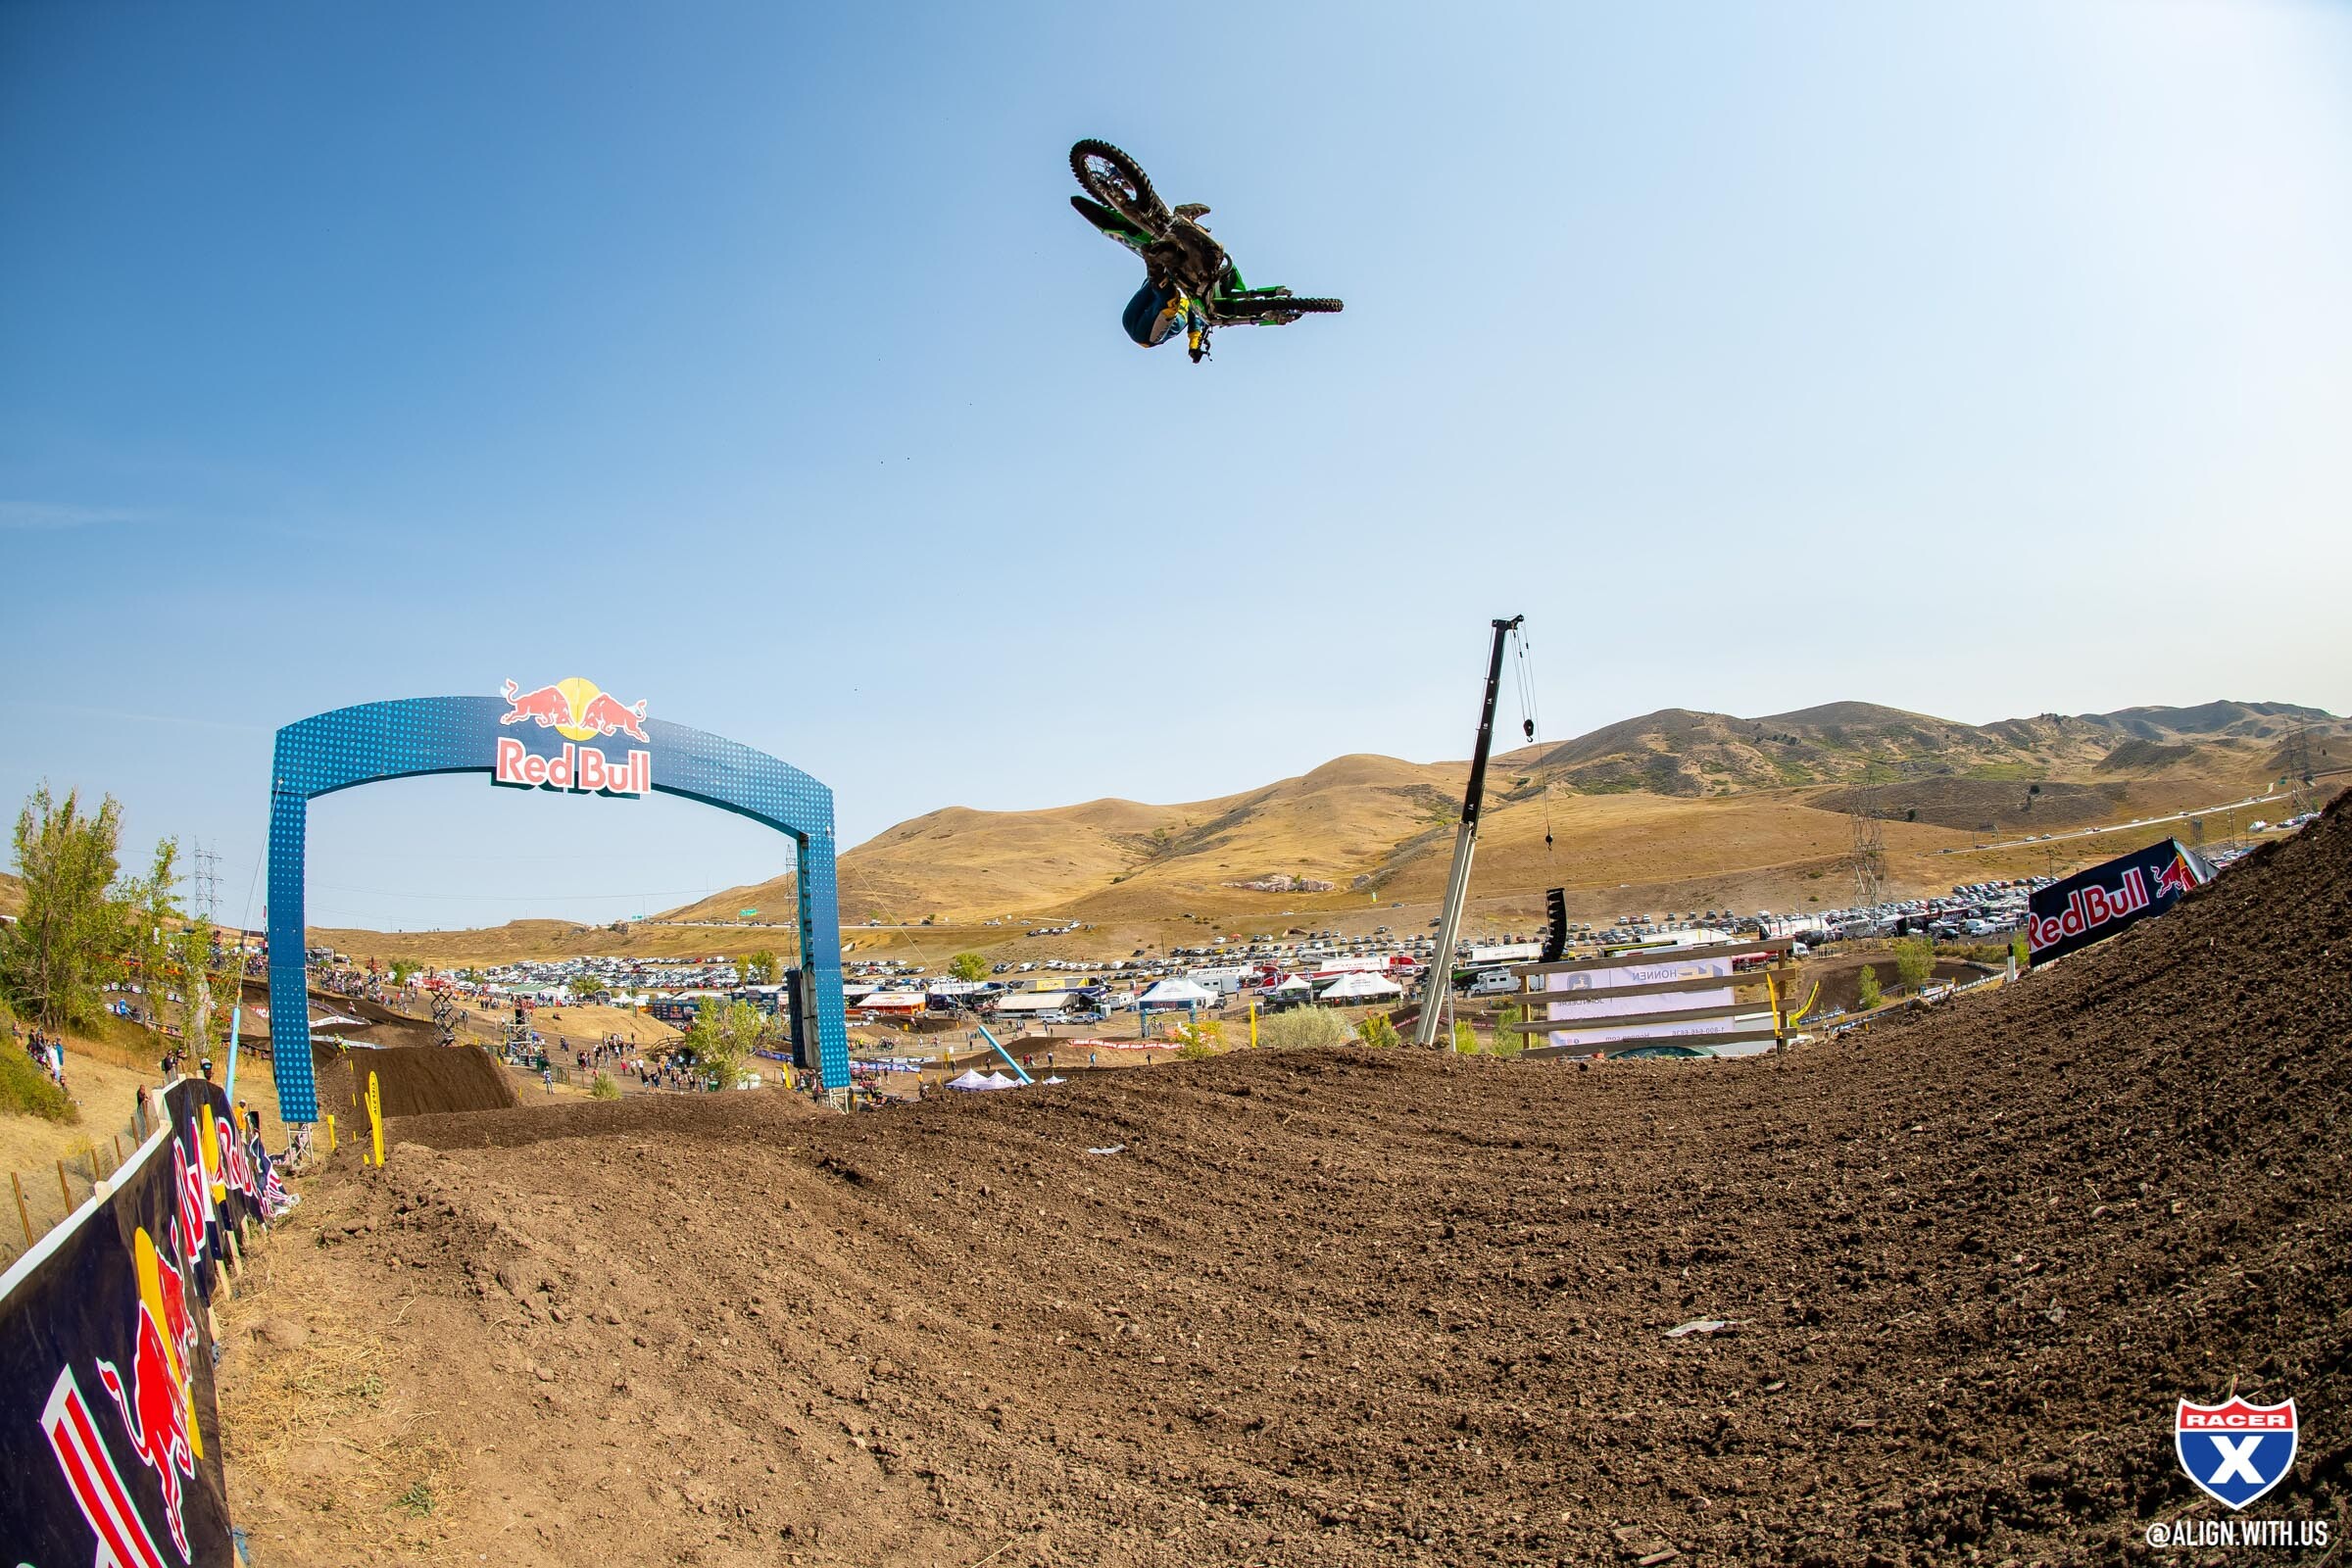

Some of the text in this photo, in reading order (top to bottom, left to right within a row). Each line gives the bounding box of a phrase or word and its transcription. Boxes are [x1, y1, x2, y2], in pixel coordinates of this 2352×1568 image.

[498, 737, 651, 795] Red Bull
[2030, 867, 2149, 953] Red Bull
